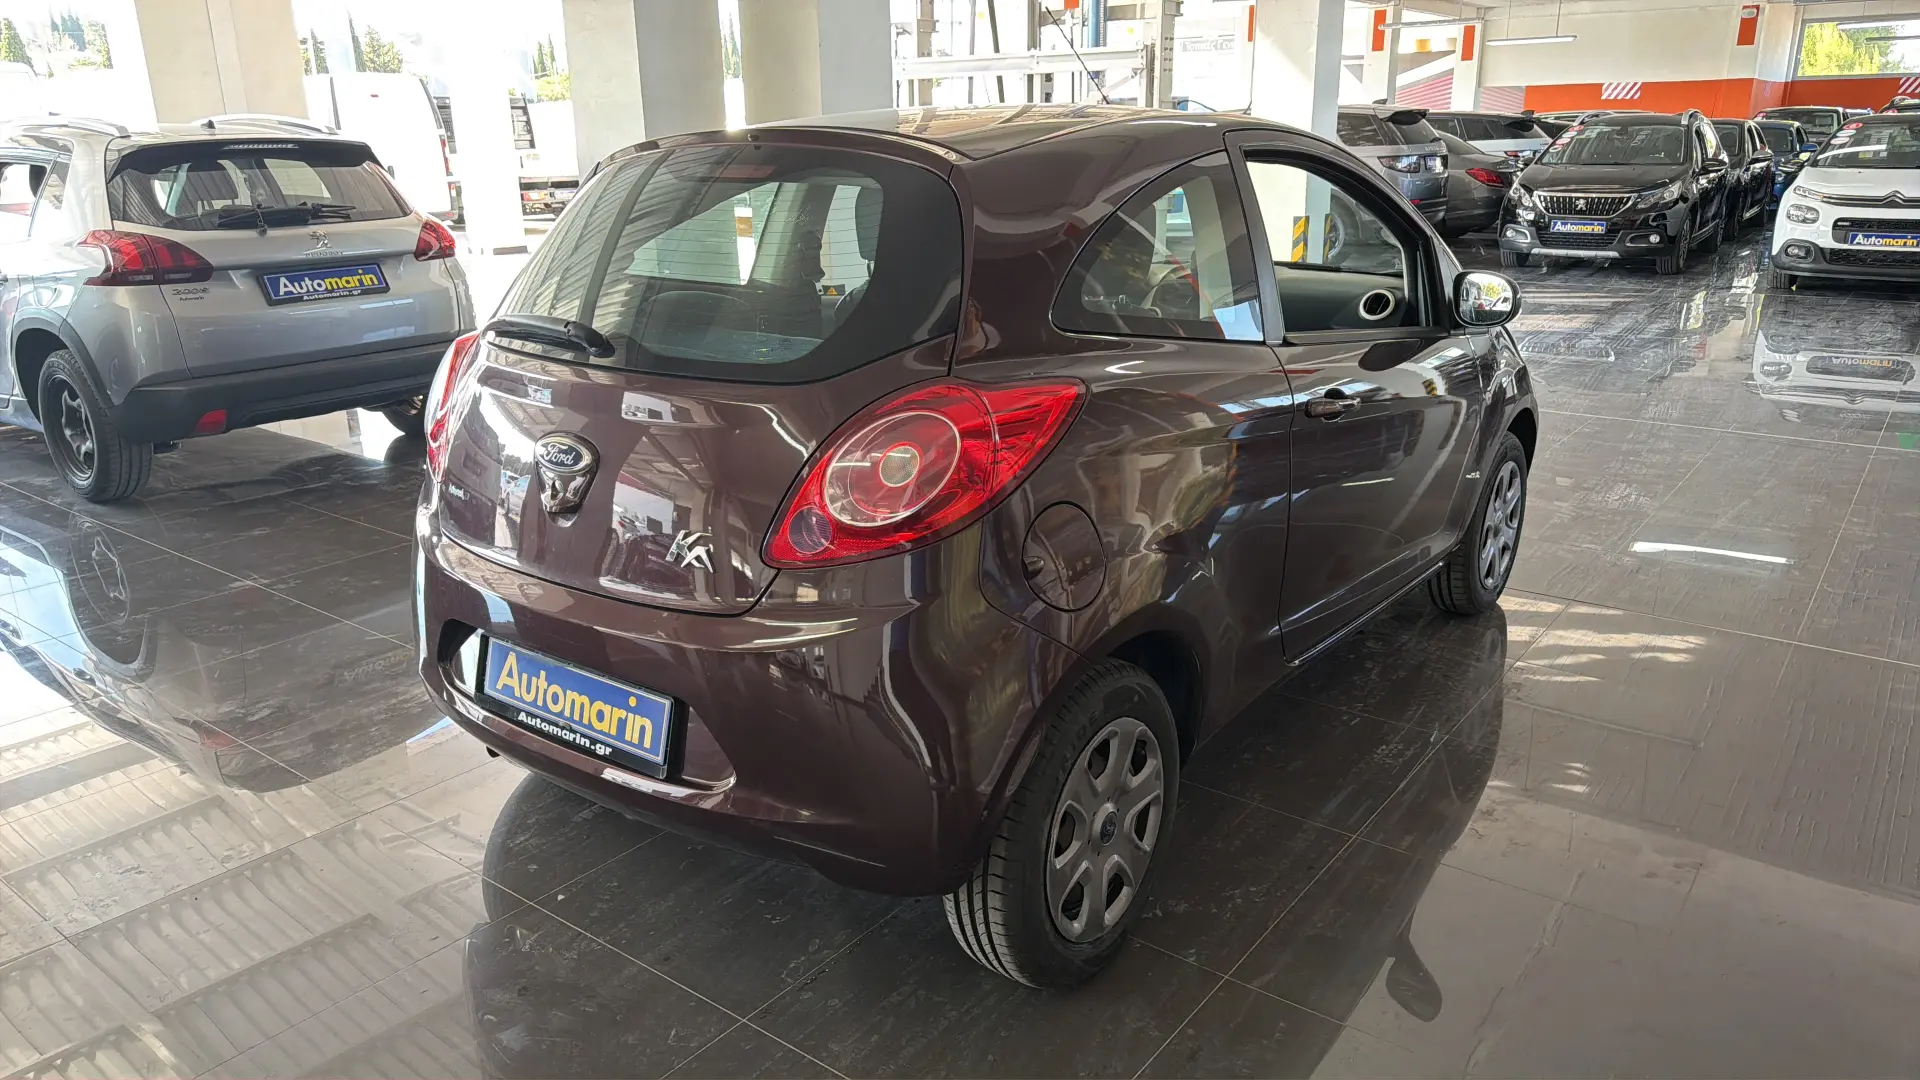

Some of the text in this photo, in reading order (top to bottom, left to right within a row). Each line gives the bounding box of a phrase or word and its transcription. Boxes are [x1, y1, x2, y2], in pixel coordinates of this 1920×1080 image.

[1554, 222, 1602, 231] Automarin
[1853, 234, 1918, 247] Automarin
[279, 268, 379, 296] Automarin
[302, 289, 362, 301] Automarin.gr
[543, 442, 575, 465] Ford
[496, 651, 653, 749] Automarin
[517, 710, 613, 757] Automarin.gr
